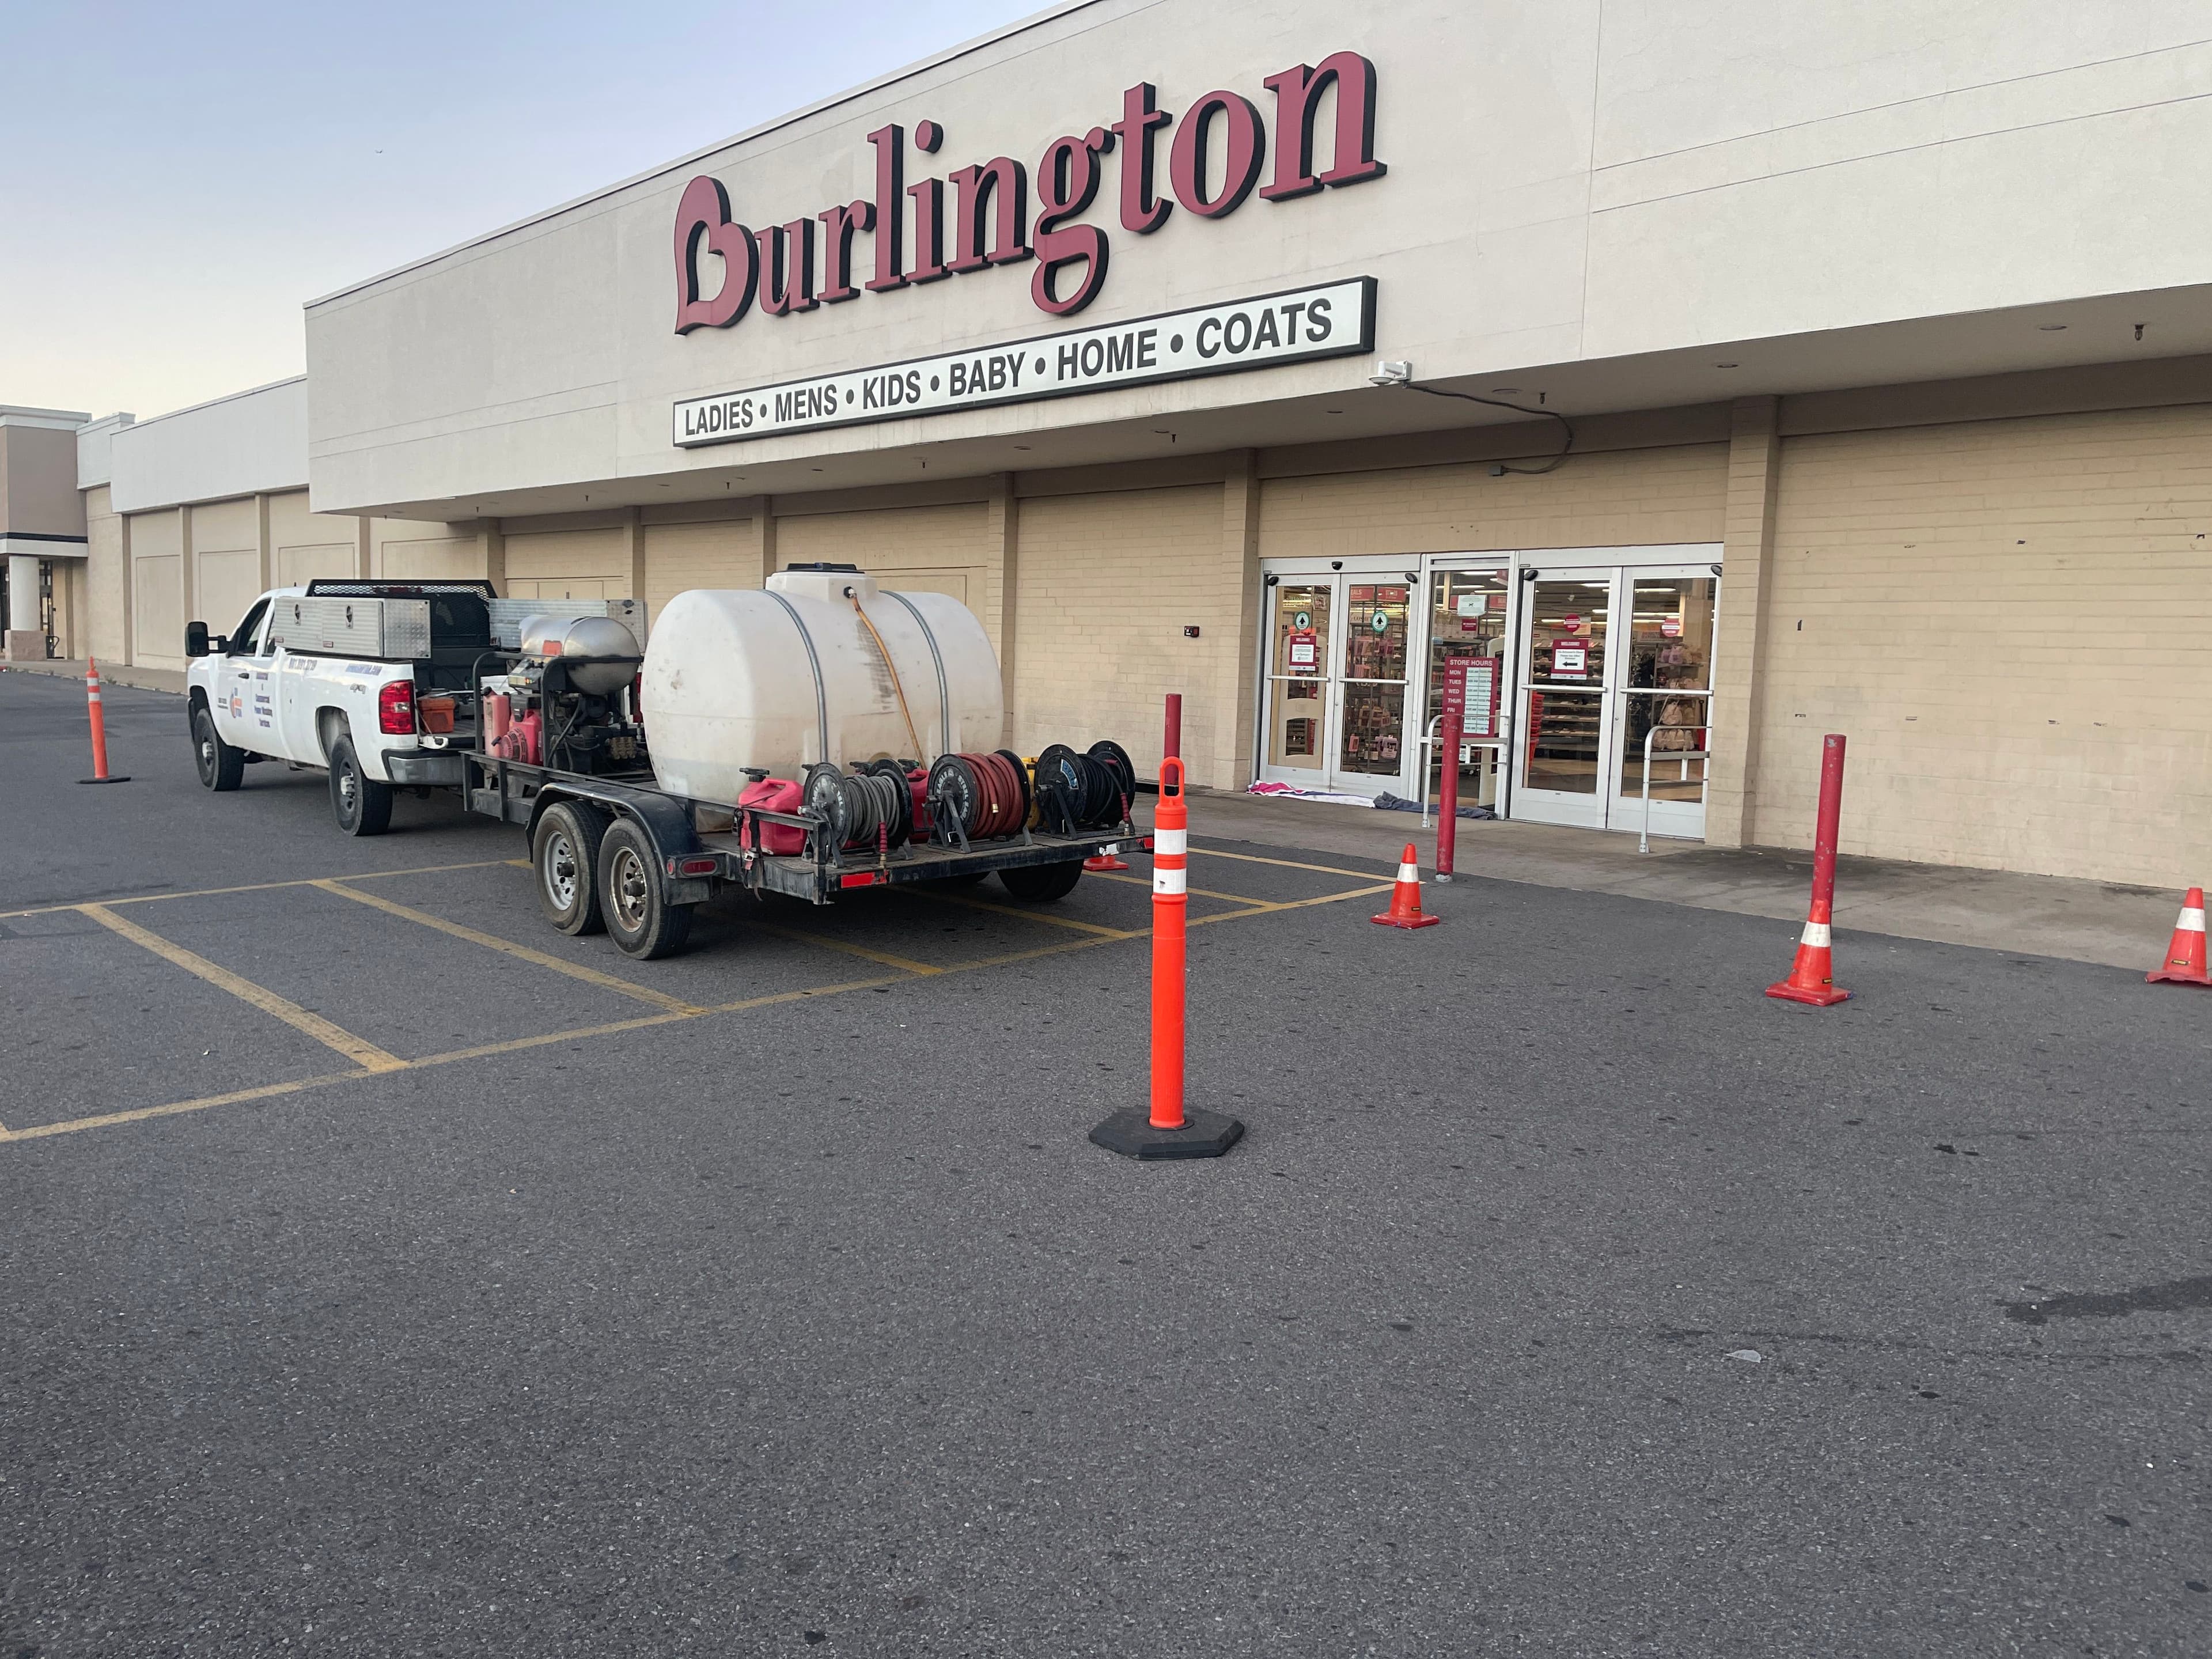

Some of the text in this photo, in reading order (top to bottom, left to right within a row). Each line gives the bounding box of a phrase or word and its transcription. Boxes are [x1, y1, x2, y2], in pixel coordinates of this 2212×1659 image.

[675, 51, 1387, 336] Burlington
[685, 298, 1332, 436] LADIES MENS KIDS BABY HOME COATS
